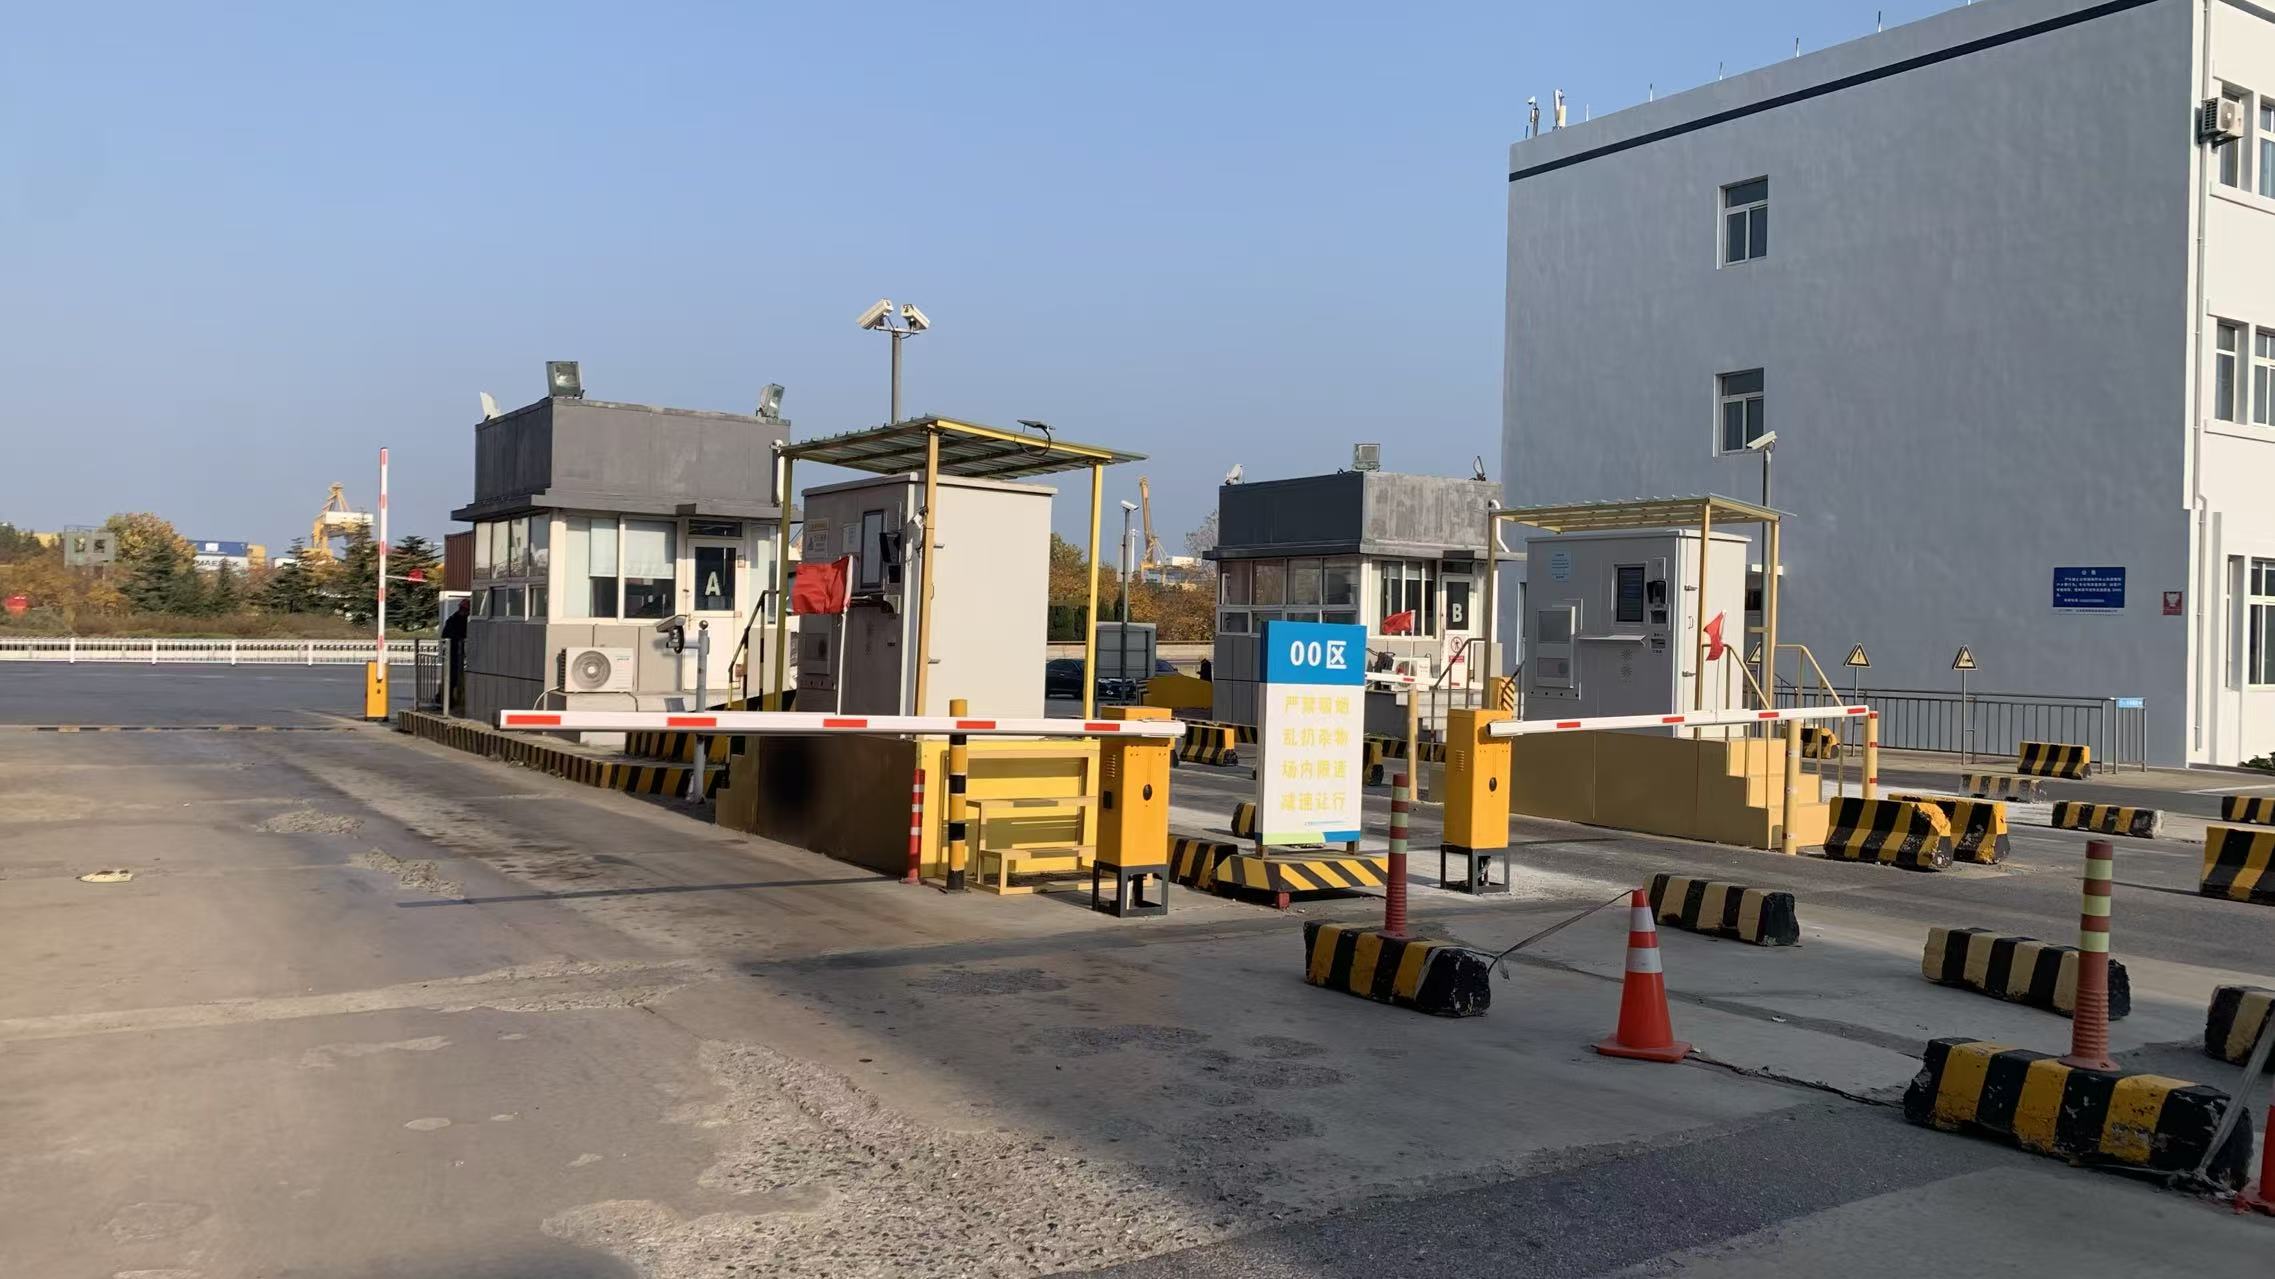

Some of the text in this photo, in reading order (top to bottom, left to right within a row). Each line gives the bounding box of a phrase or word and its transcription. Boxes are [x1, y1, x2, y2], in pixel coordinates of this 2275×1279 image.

[705, 571, 721, 596] A
[1452, 603, 1463, 623] B
[1290, 640, 1347, 669] 00区
